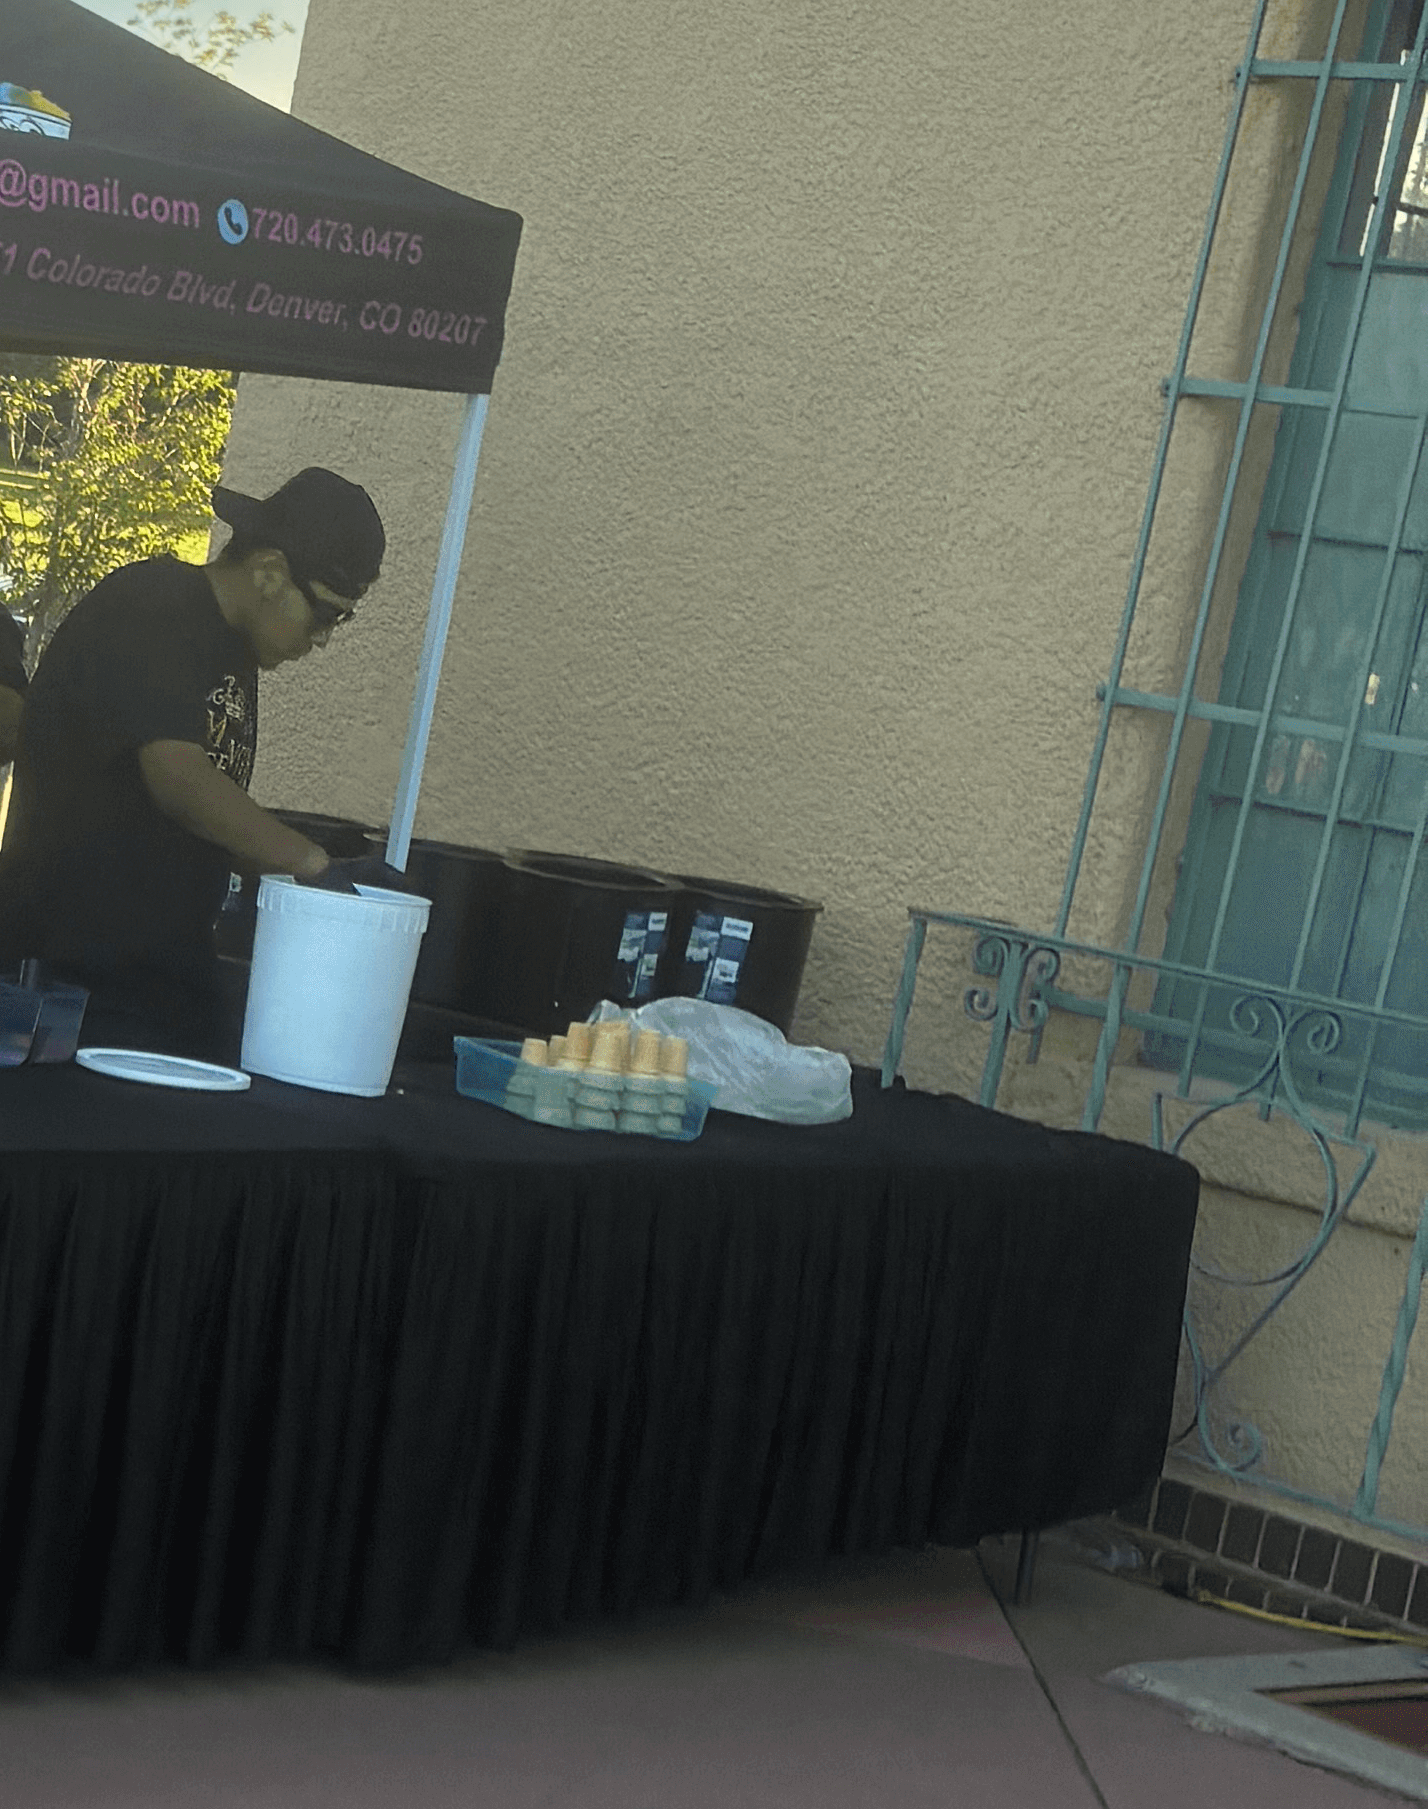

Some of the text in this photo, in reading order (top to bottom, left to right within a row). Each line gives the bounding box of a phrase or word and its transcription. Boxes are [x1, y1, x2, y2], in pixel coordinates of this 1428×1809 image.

[251, 208, 423, 265] 720.473.0475
[26, 248, 162, 297] Colorado
[359, 300, 402, 334] CO
[407, 308, 488, 346] 80207
